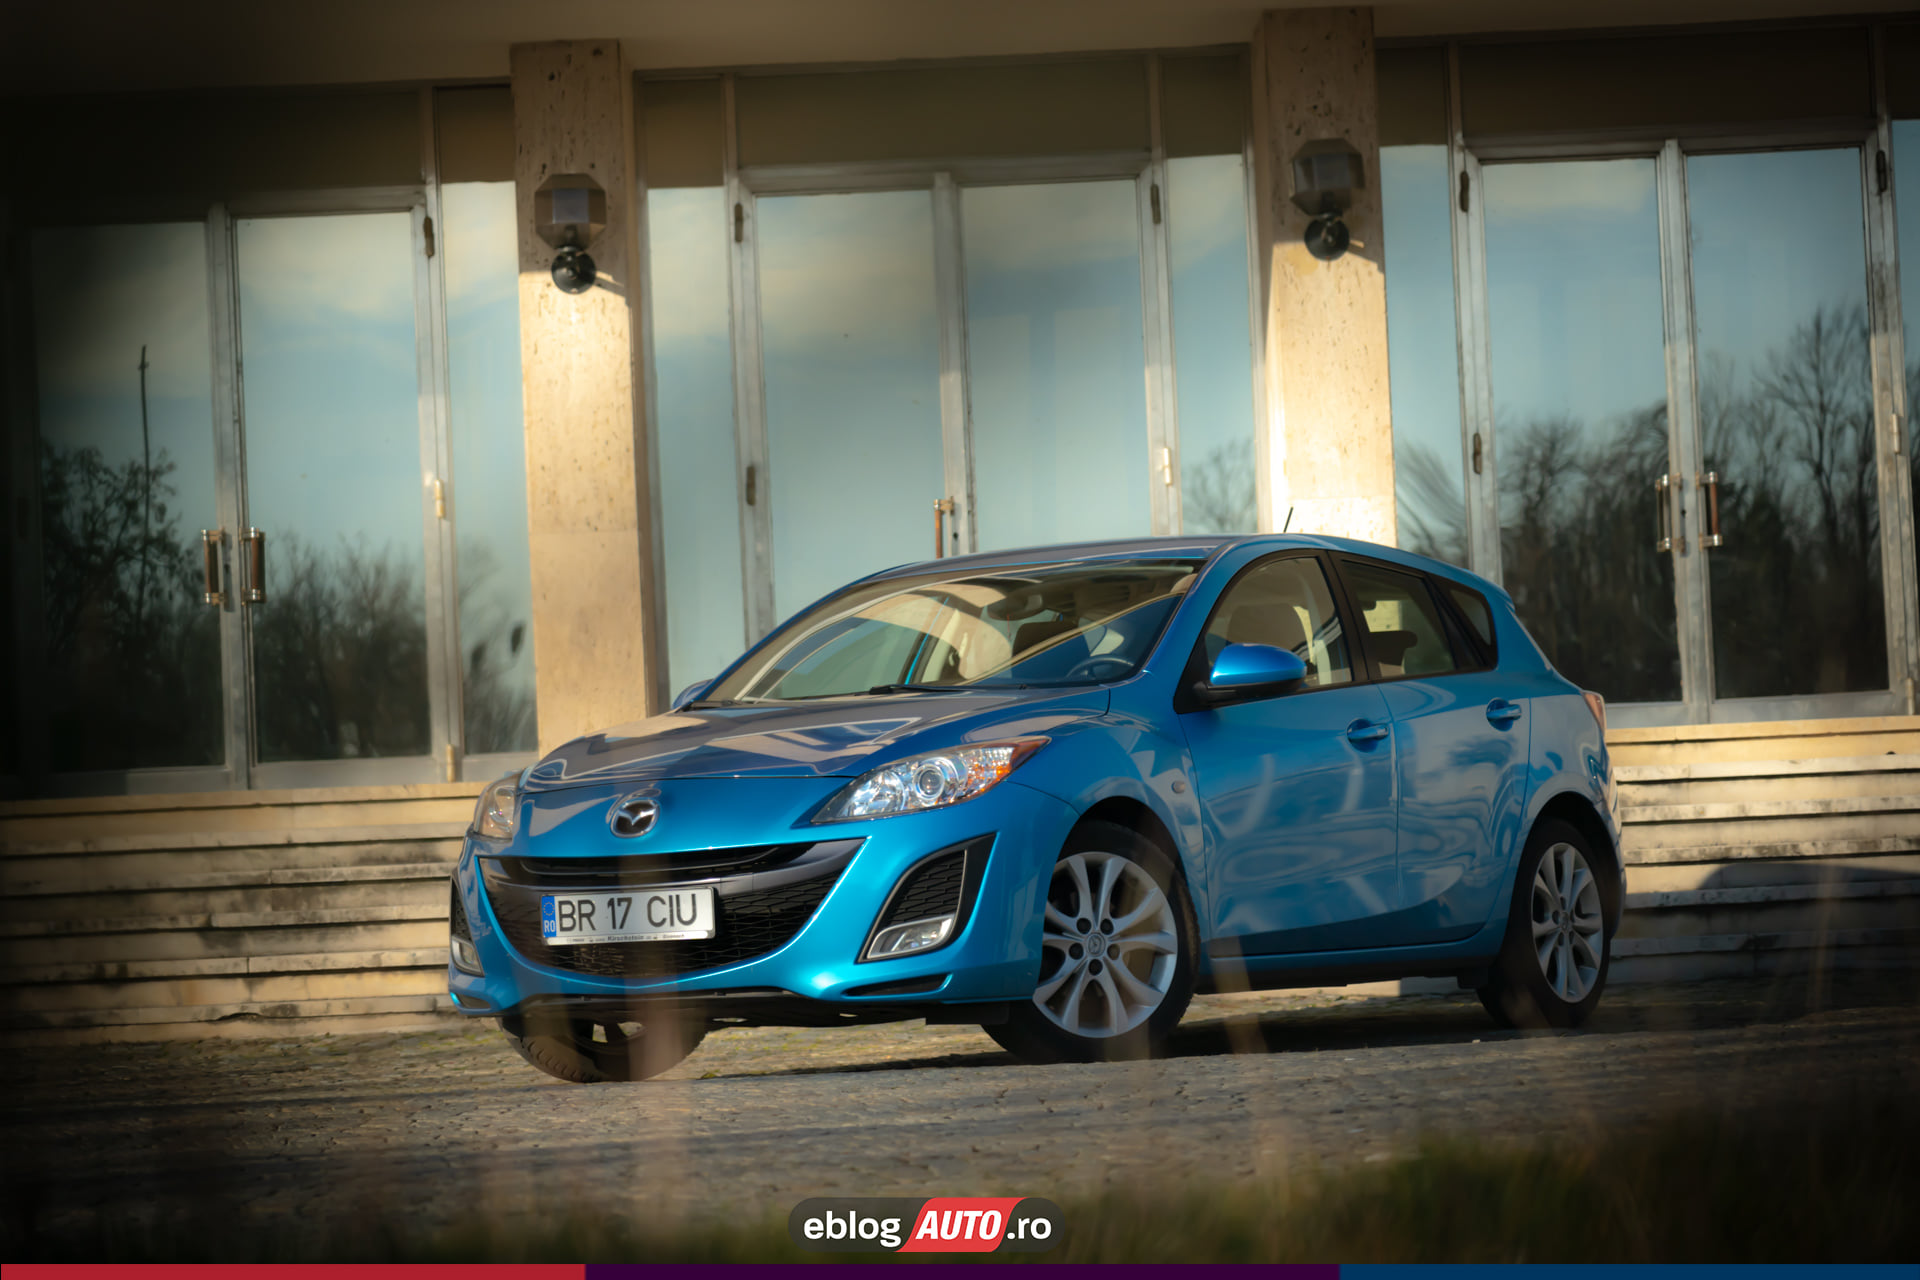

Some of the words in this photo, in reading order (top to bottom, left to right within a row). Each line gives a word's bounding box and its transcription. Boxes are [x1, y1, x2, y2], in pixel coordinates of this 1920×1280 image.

[558, 900, 596, 932] BR
[607, 897, 633, 930] 17
[647, 893, 698, 927] CIU
[544, 920, 556, 932] RO
